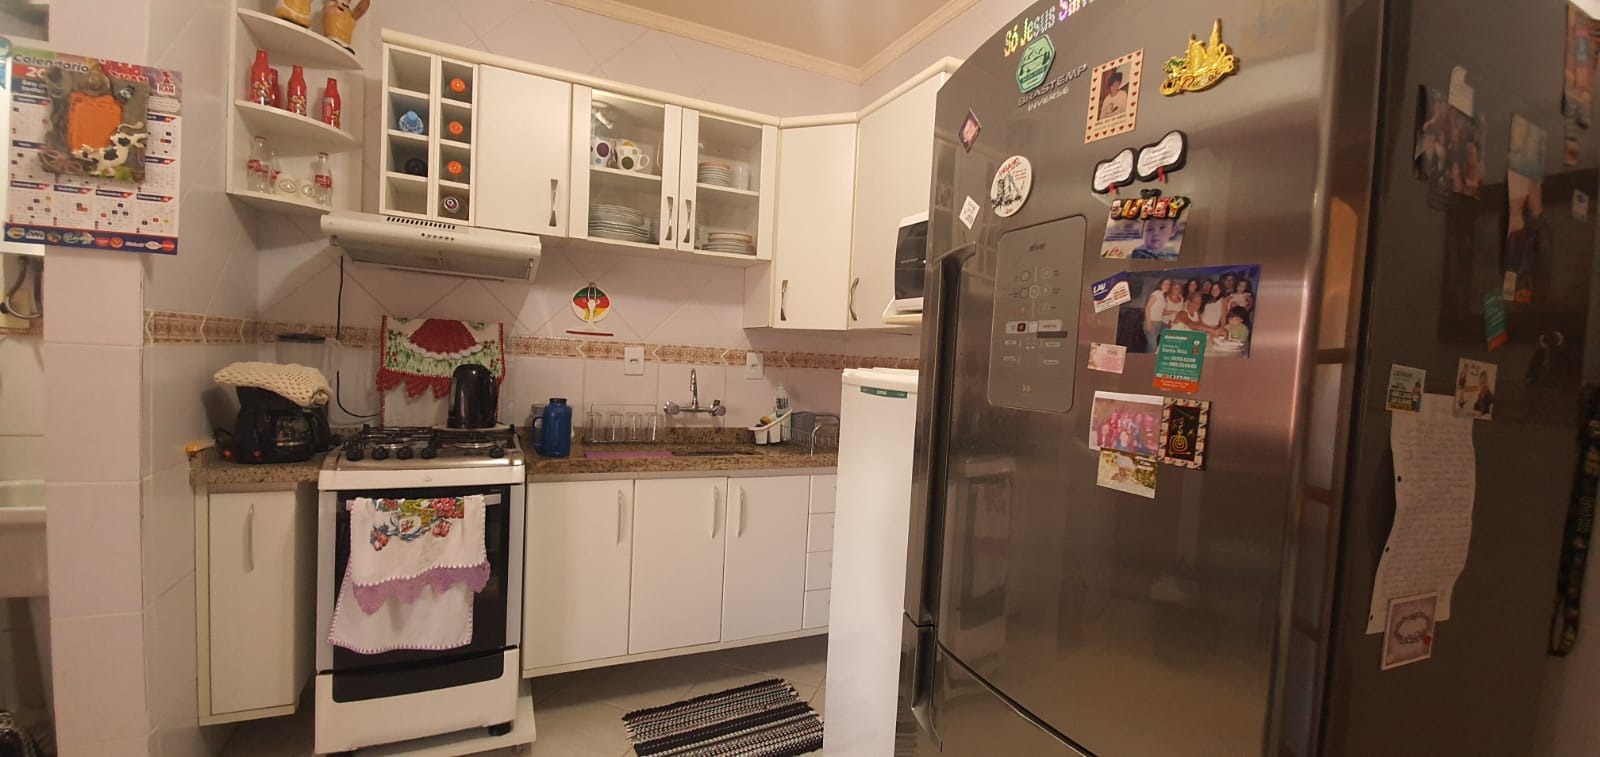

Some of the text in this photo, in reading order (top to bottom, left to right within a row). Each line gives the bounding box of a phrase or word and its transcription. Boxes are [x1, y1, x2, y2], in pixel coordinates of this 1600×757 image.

[1020, 6, 1056, 47] Jesus
[1017, 63, 1088, 108] BRASTEMP
[1027, 86, 1070, 112] INVERSE
